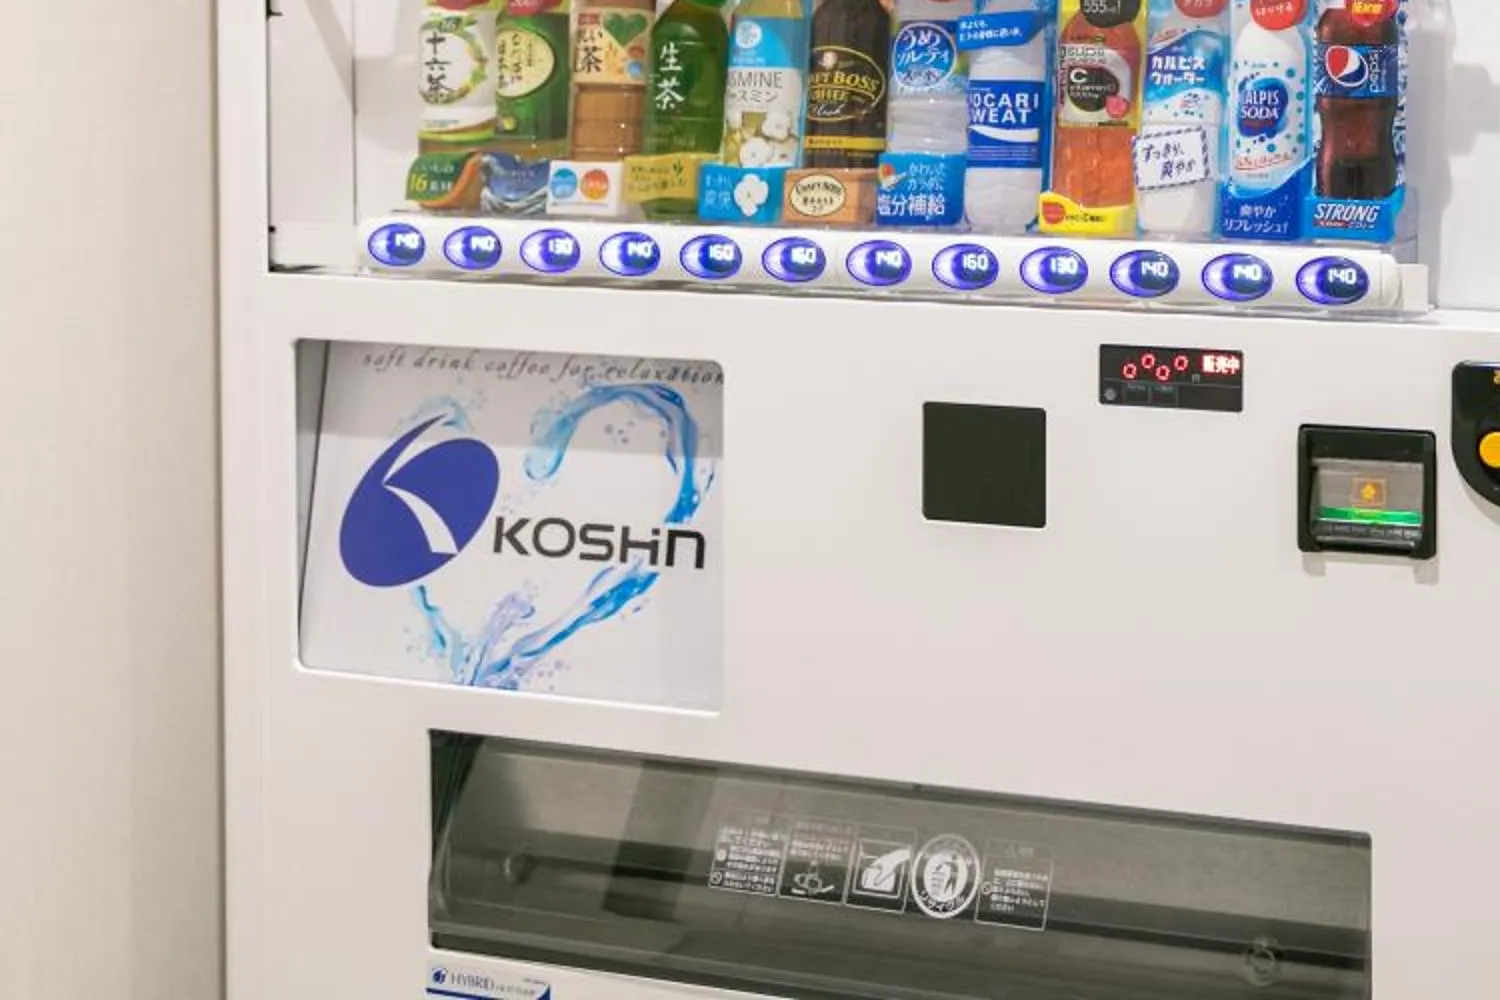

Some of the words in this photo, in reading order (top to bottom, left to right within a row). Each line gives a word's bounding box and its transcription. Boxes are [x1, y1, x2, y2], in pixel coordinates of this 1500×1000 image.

[425, 31, 453, 92] 十六茶
[1151, 56, 1206, 71] カルピス
[655, 41, 684, 110] 生茶
[728, 70, 784, 89] SMINE
[832, 71, 880, 93] BOSS
[1069, 68, 1089, 83] C
[1150, 72, 1206, 86] ウォーター
[728, 89, 779, 103] ャスミン
[971, 108, 1032, 124] WEAT
[1240, 103, 1281, 120] SODA
[1160, 158, 1197, 180] 爽やか
[877, 193, 946, 217] 塩分補給
[1238, 204, 1277, 218] 爽やか
[1313, 202, 1381, 222] STRONG
[1223, 218, 1289, 234] リフレッシュ!
[709, 243, 735, 261] 160
[963, 253, 989, 271] 160
[1141, 261, 1167, 278] 140
[1328, 268, 1357, 285] 140
[362, 350, 404, 370] soft
[412, 352, 474, 371] drink
[484, 353, 551, 384] coffee
[551, 355, 594, 384] for
[602, 356, 725, 386] relaxation
[1201, 353, 1241, 375] 販売中
